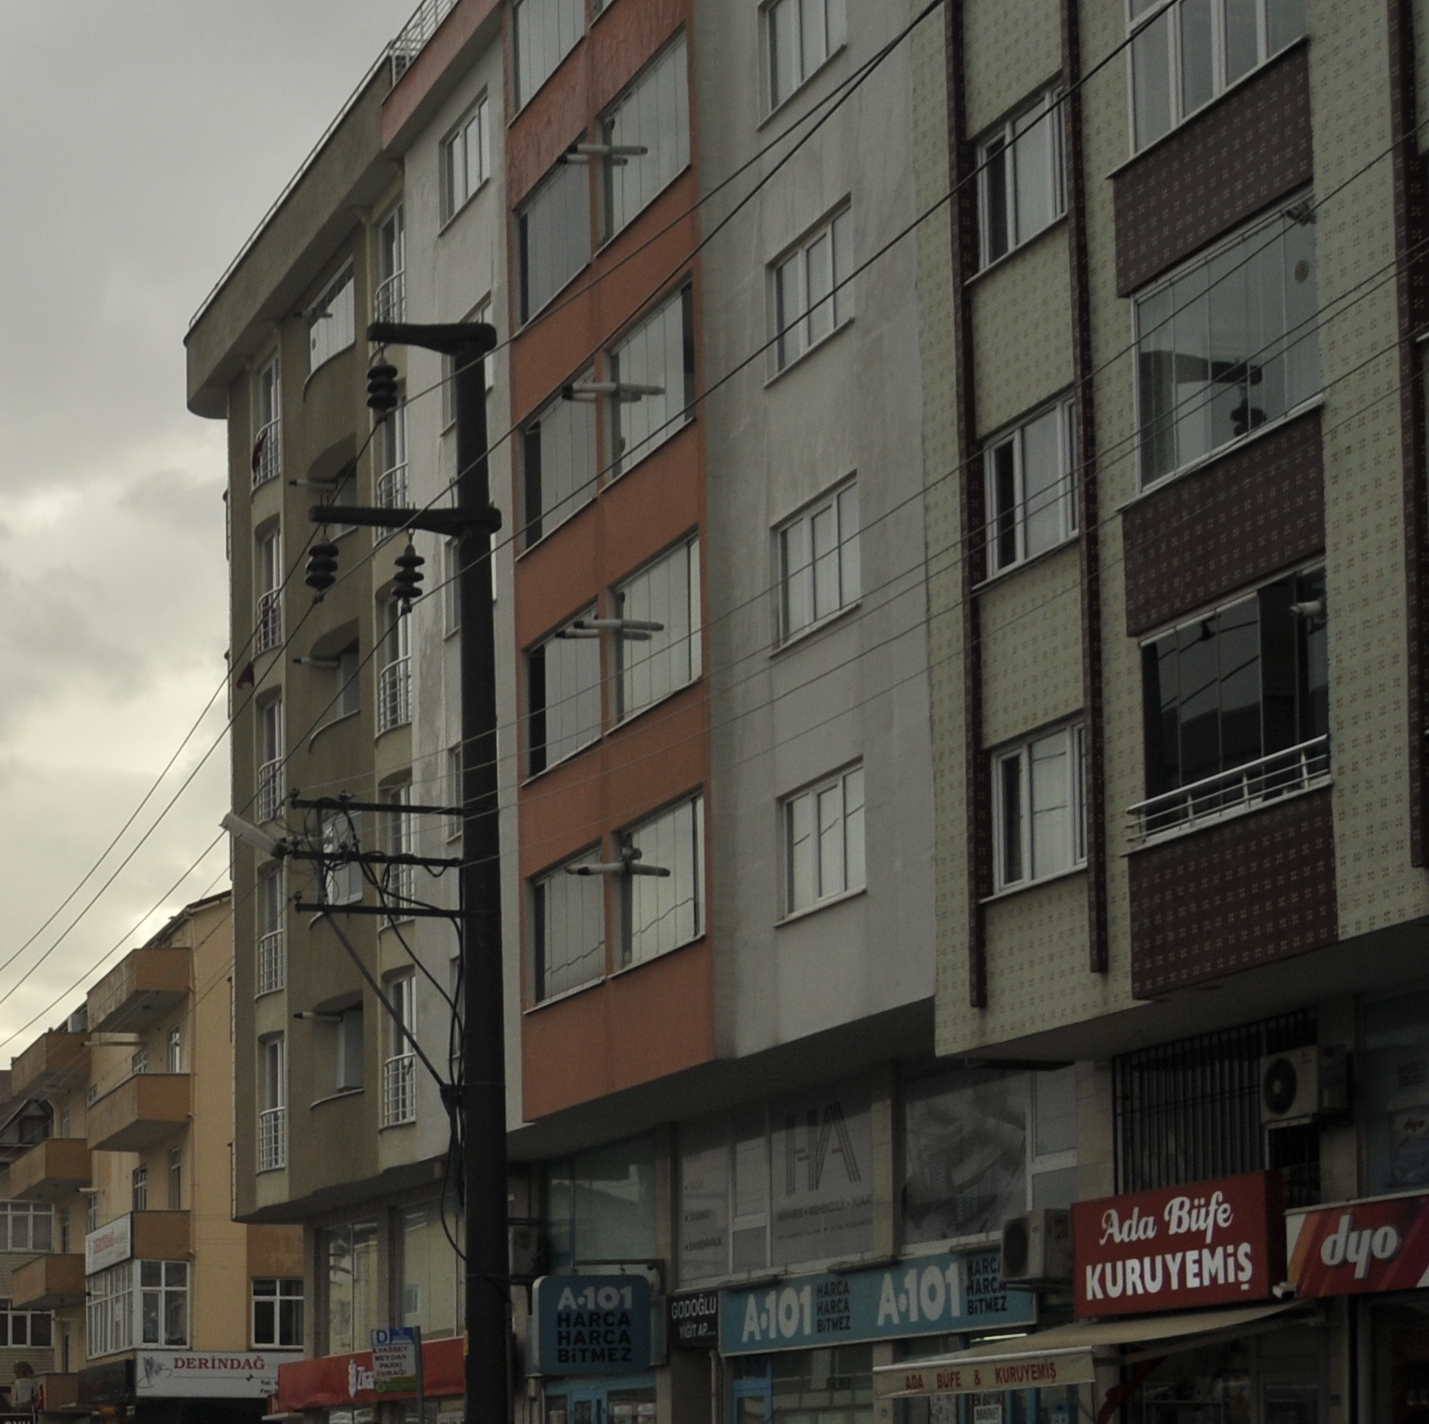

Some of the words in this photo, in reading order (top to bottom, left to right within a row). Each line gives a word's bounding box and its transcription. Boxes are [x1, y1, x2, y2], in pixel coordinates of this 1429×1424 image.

[1098, 1207, 1157, 1245] Ada
[1163, 1190, 1234, 1244] Büfe
[1320, 1213, 1403, 1281] dyo
[967, 1256, 1001, 1278] HARC
[816, 1281, 850, 1299] HARCA
[816, 1298, 850, 1316] HARCA
[557, 1311, 631, 1328] HARCA
[376, 1330, 389, 1344] D
[557, 1330, 631, 1346] HARCA
[173, 1354, 266, 1370] DERİNDAĞ
[905, 1374, 924, 1391] ADA
